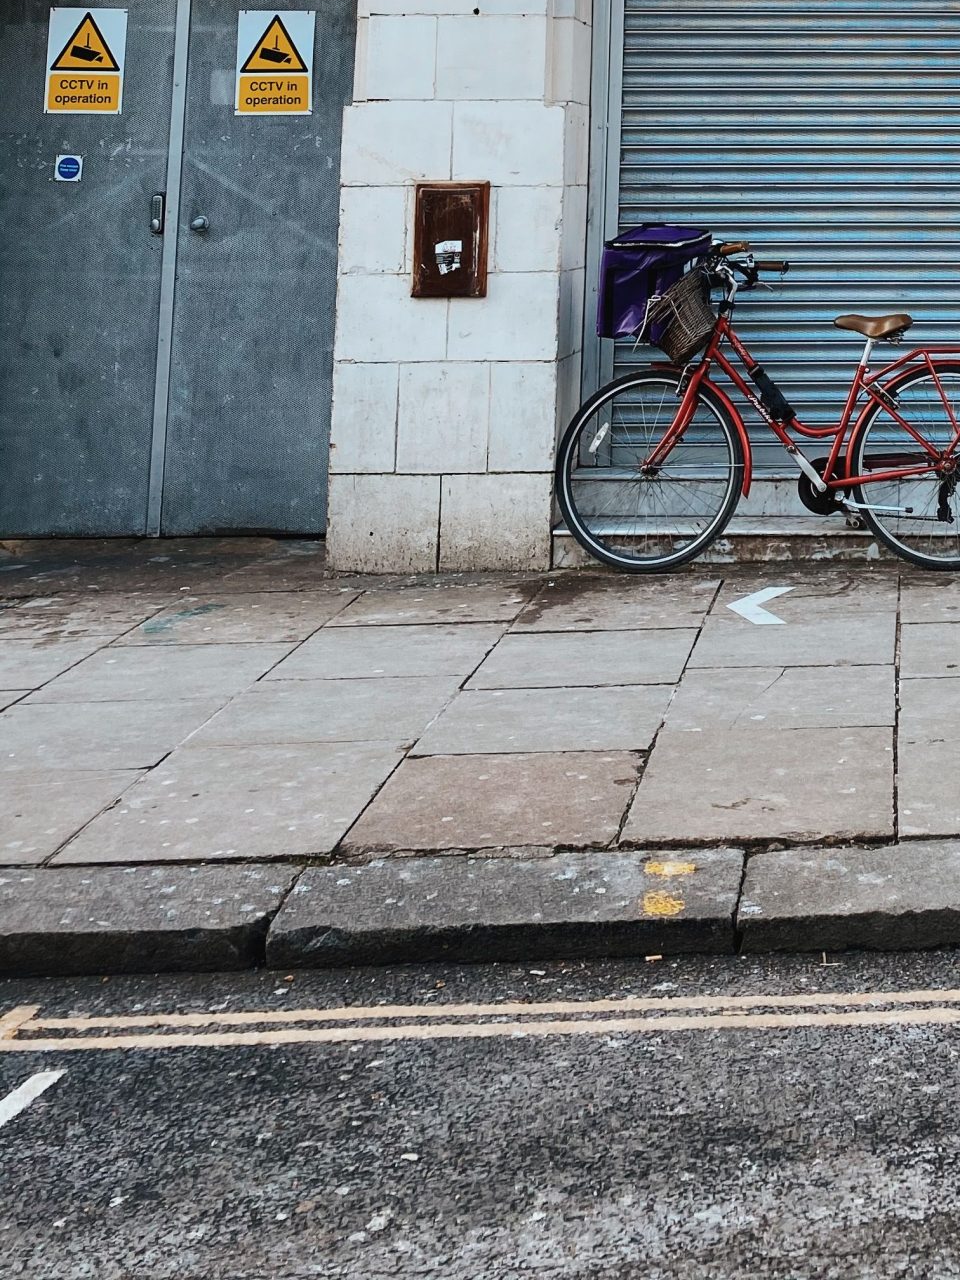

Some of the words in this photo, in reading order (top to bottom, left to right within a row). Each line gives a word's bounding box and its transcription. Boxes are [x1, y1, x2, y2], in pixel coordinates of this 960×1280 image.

[60, 79, 94, 90] CCTV
[97, 80, 108, 90] in
[249, 81, 284, 91] CCTV
[287, 81, 297, 91] in
[55, 93, 111, 105] operation
[245, 95, 301, 107] operation
